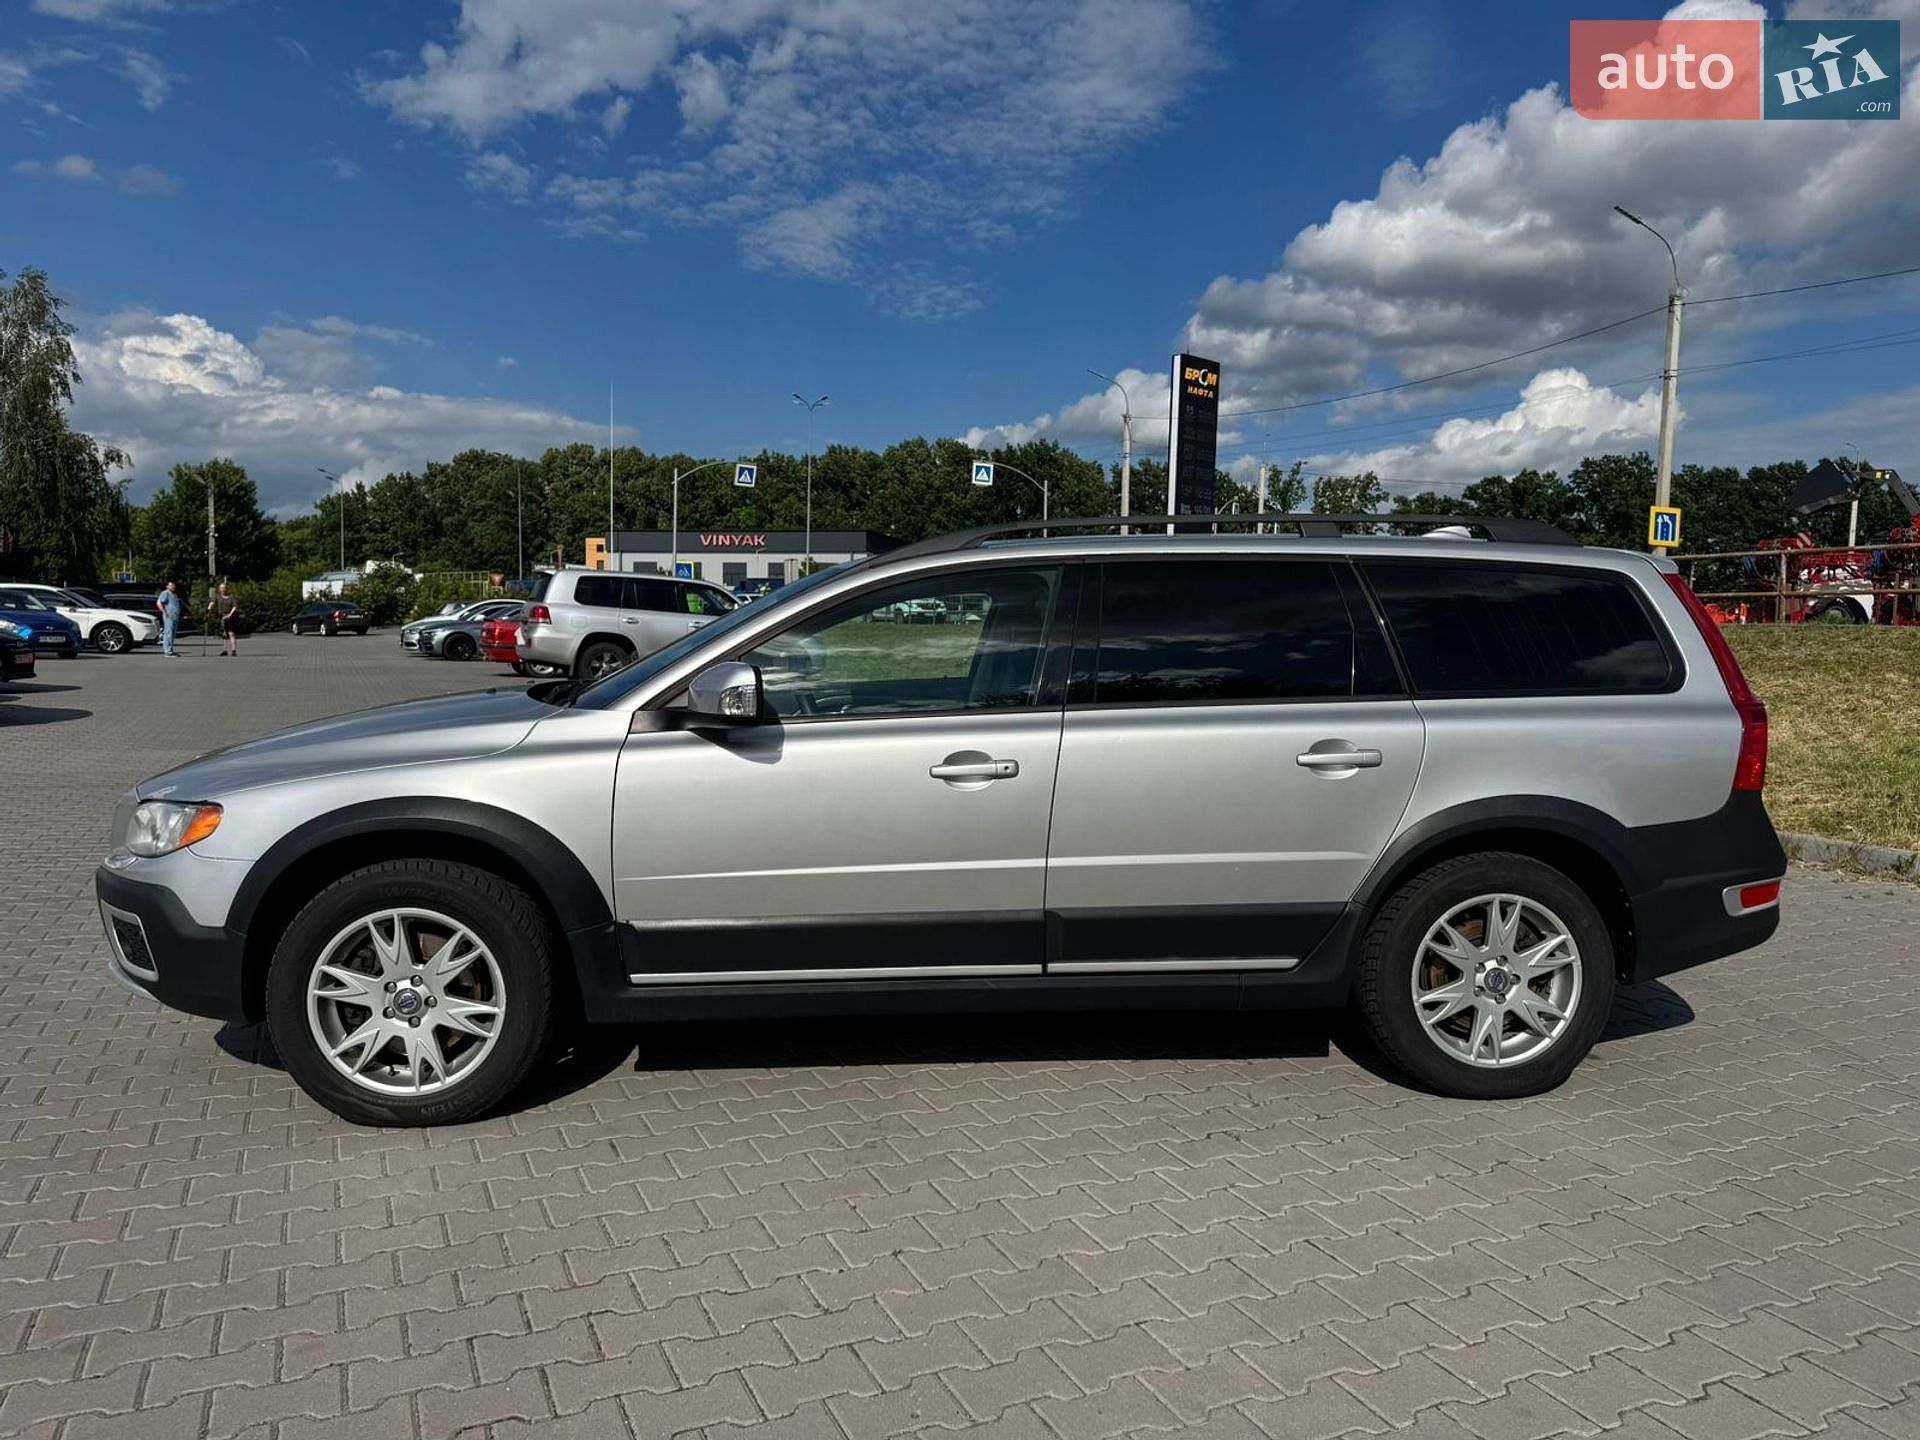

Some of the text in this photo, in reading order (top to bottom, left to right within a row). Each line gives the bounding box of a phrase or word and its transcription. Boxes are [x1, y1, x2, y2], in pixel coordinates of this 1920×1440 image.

[1185, 367, 1218, 386] БРСМ
[1187, 385, 1214, 399] НАФТА
[700, 534, 766, 547] VINYAK
